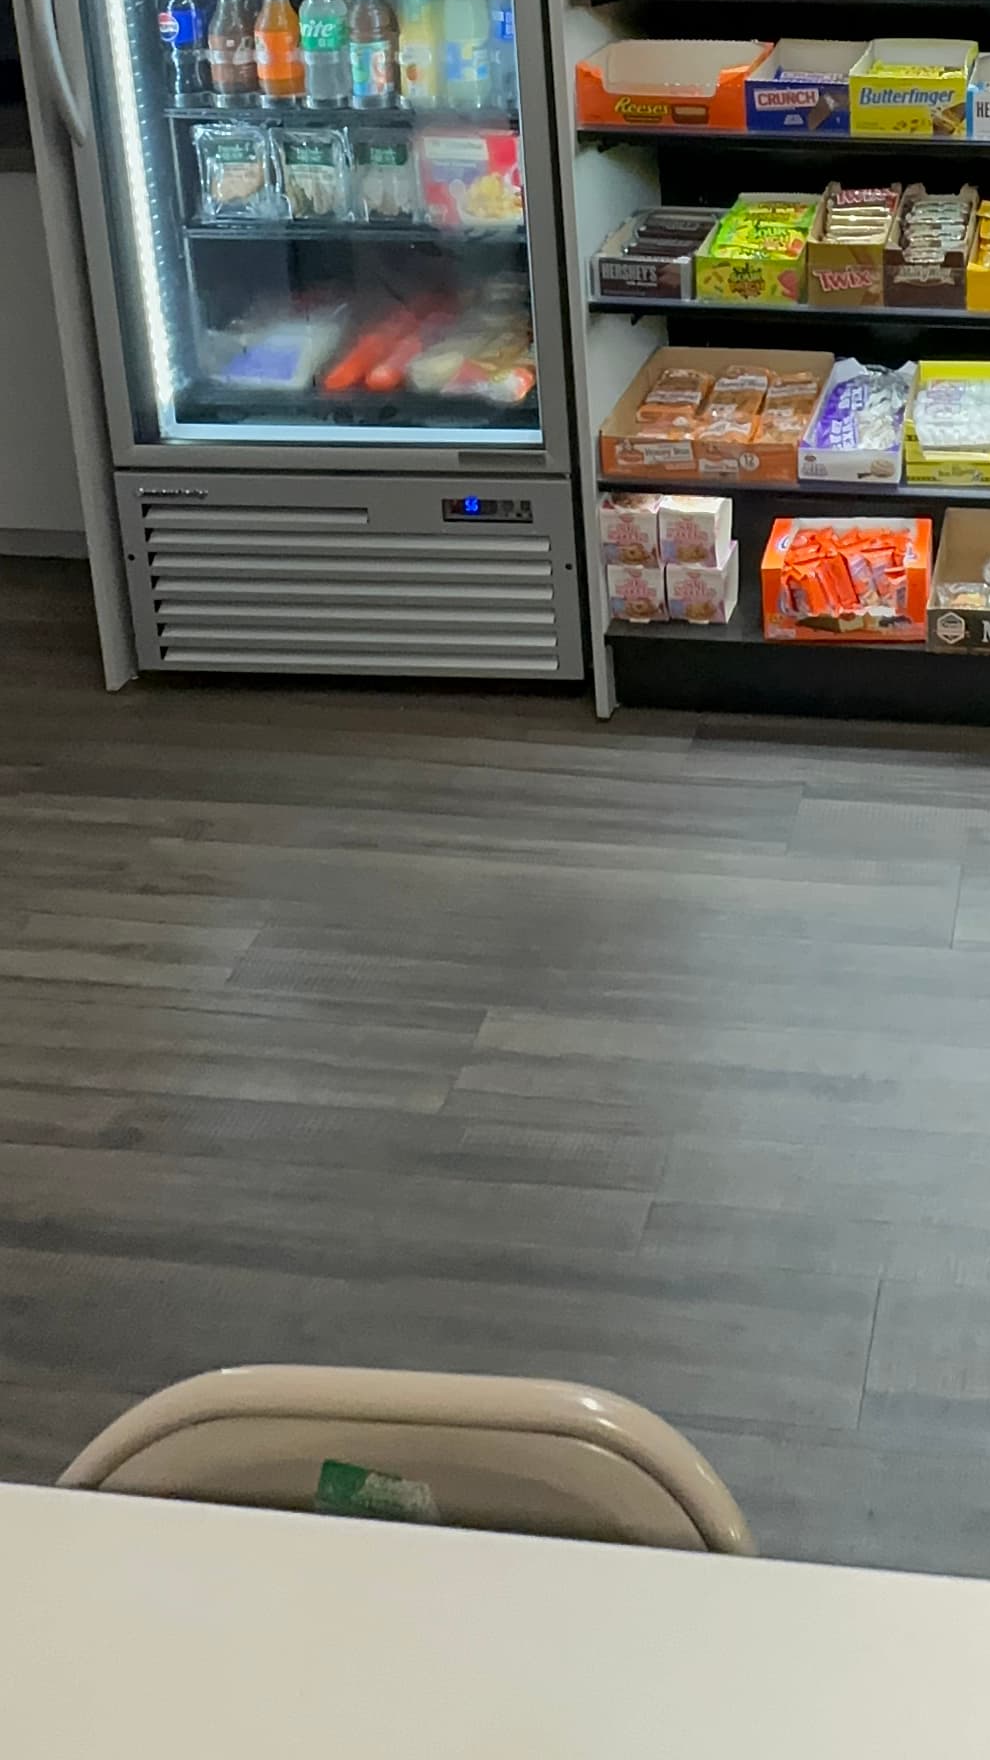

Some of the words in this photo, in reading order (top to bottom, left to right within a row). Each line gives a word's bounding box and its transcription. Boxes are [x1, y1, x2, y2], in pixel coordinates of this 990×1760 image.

[757, 90, 816, 108] CRUNCH
[859, 87, 955, 107] Butterfinger
[601, 263, 658, 282] HERSHEY'S
